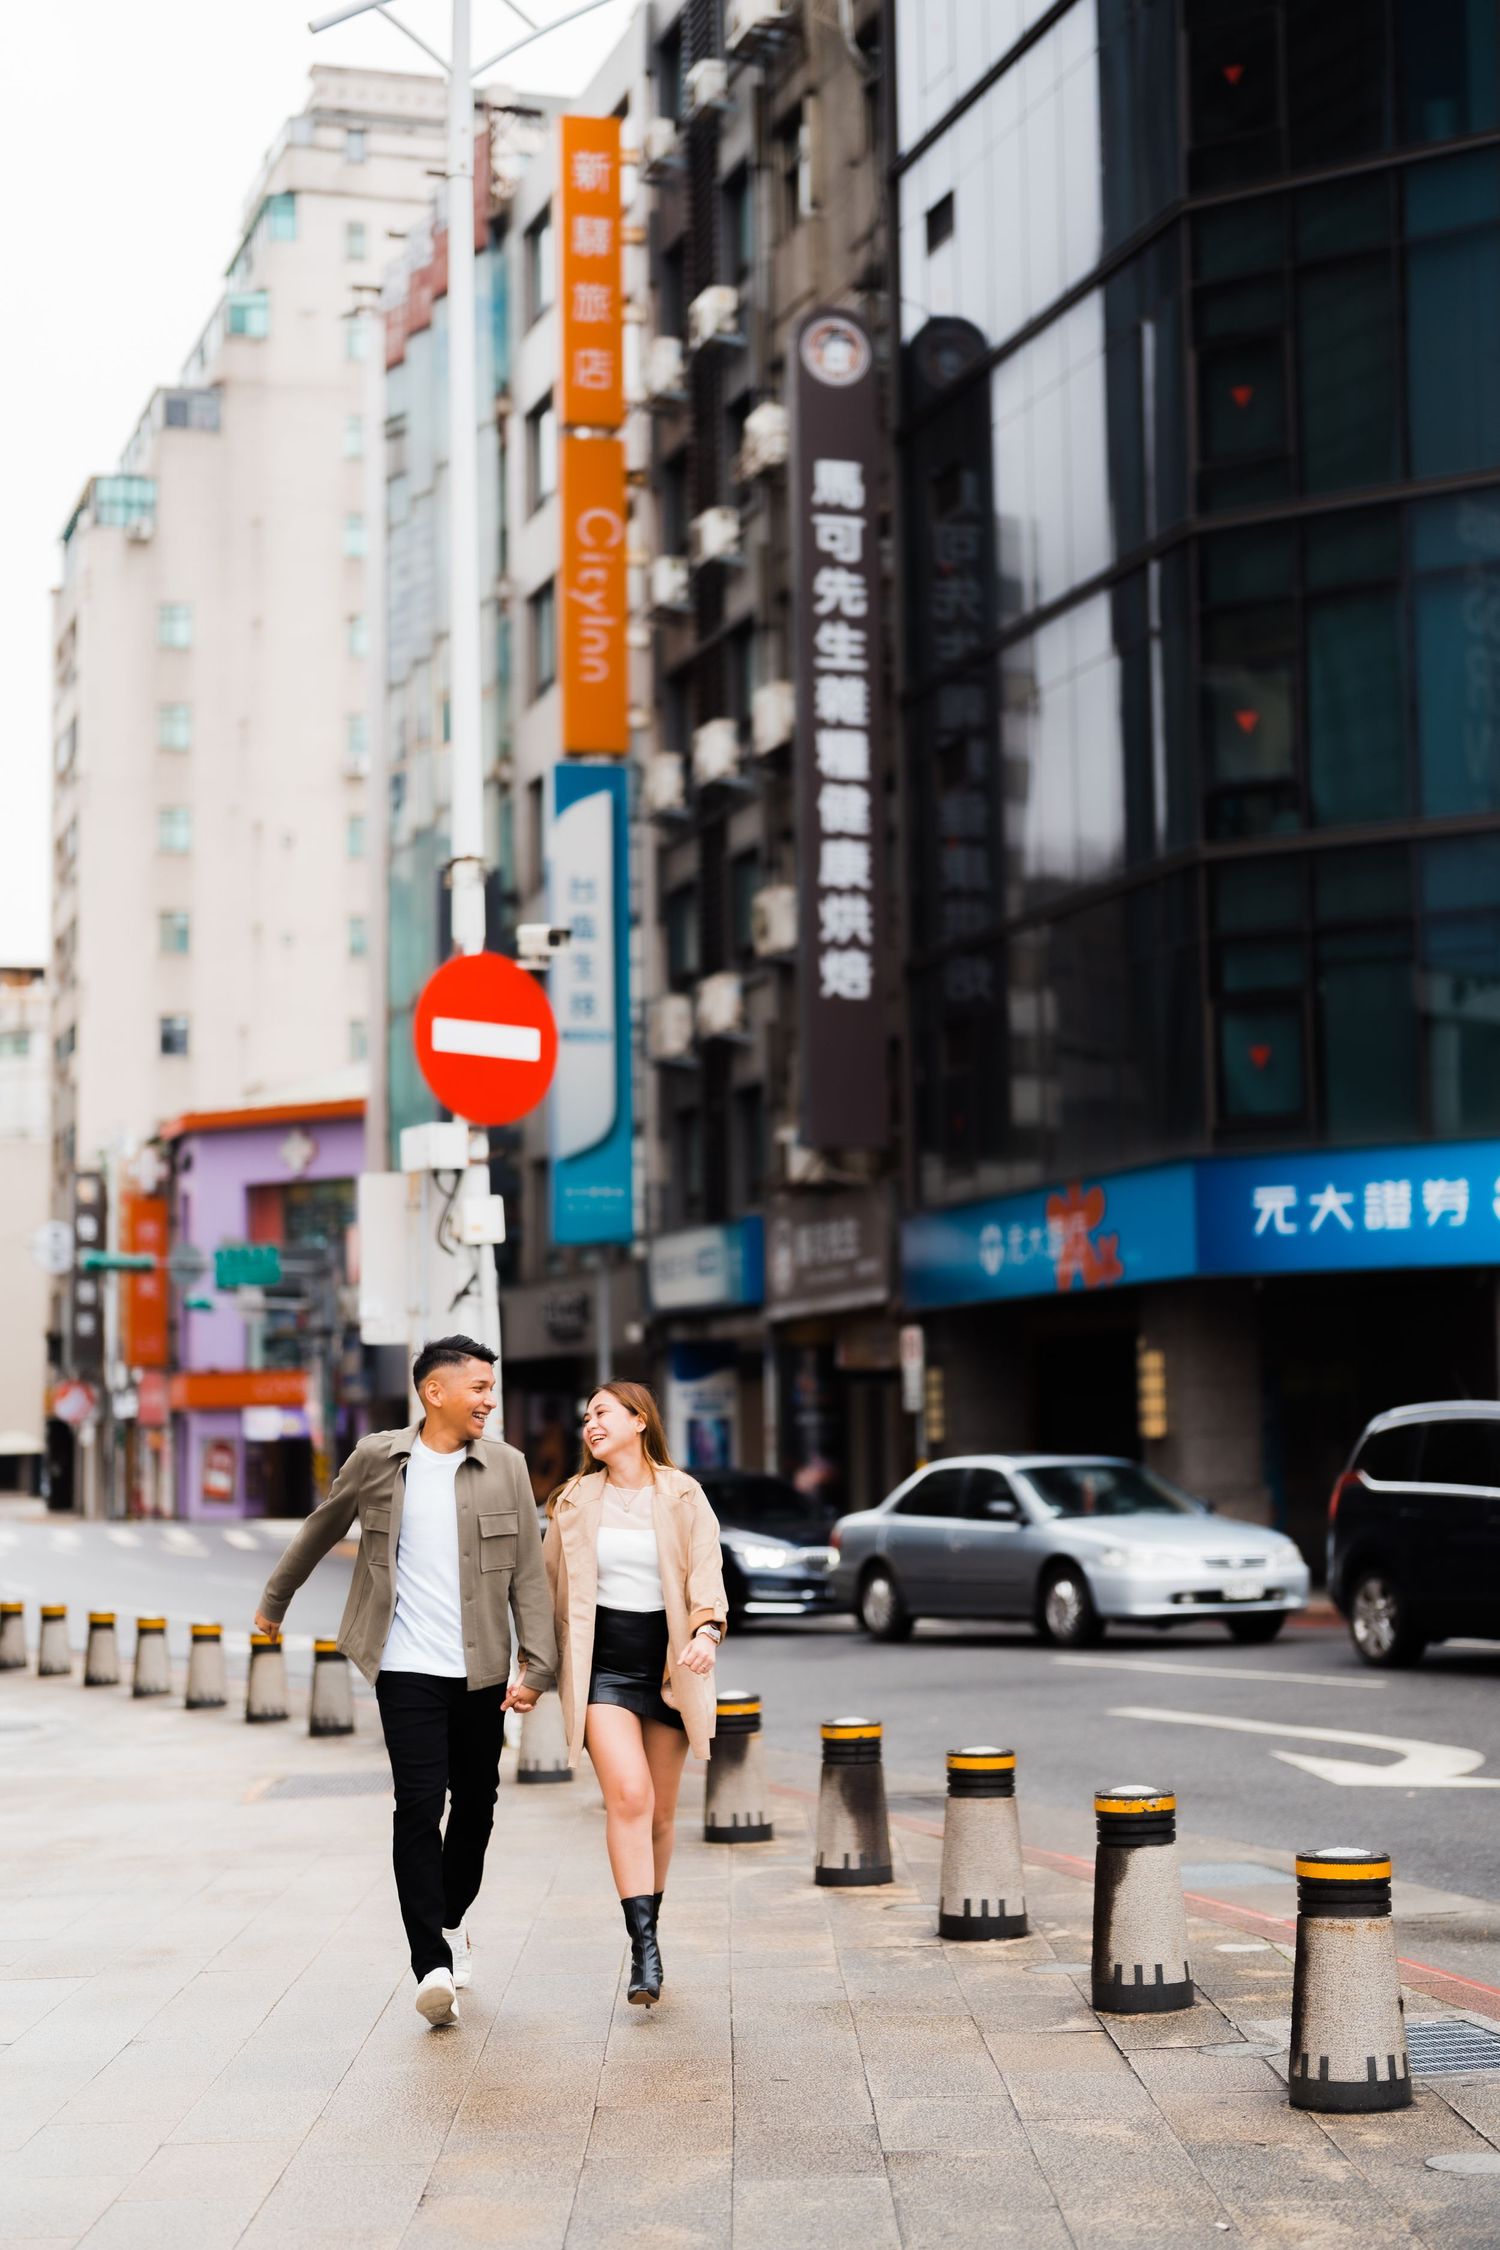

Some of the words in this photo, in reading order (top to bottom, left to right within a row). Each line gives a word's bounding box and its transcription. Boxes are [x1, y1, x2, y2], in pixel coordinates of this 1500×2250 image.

[569, 507, 625, 684] CityInn
[811, 458, 874, 1000] 馬可先生雜糧健康烘焙
[1253, 1178, 1470, 1237] 元大證券
